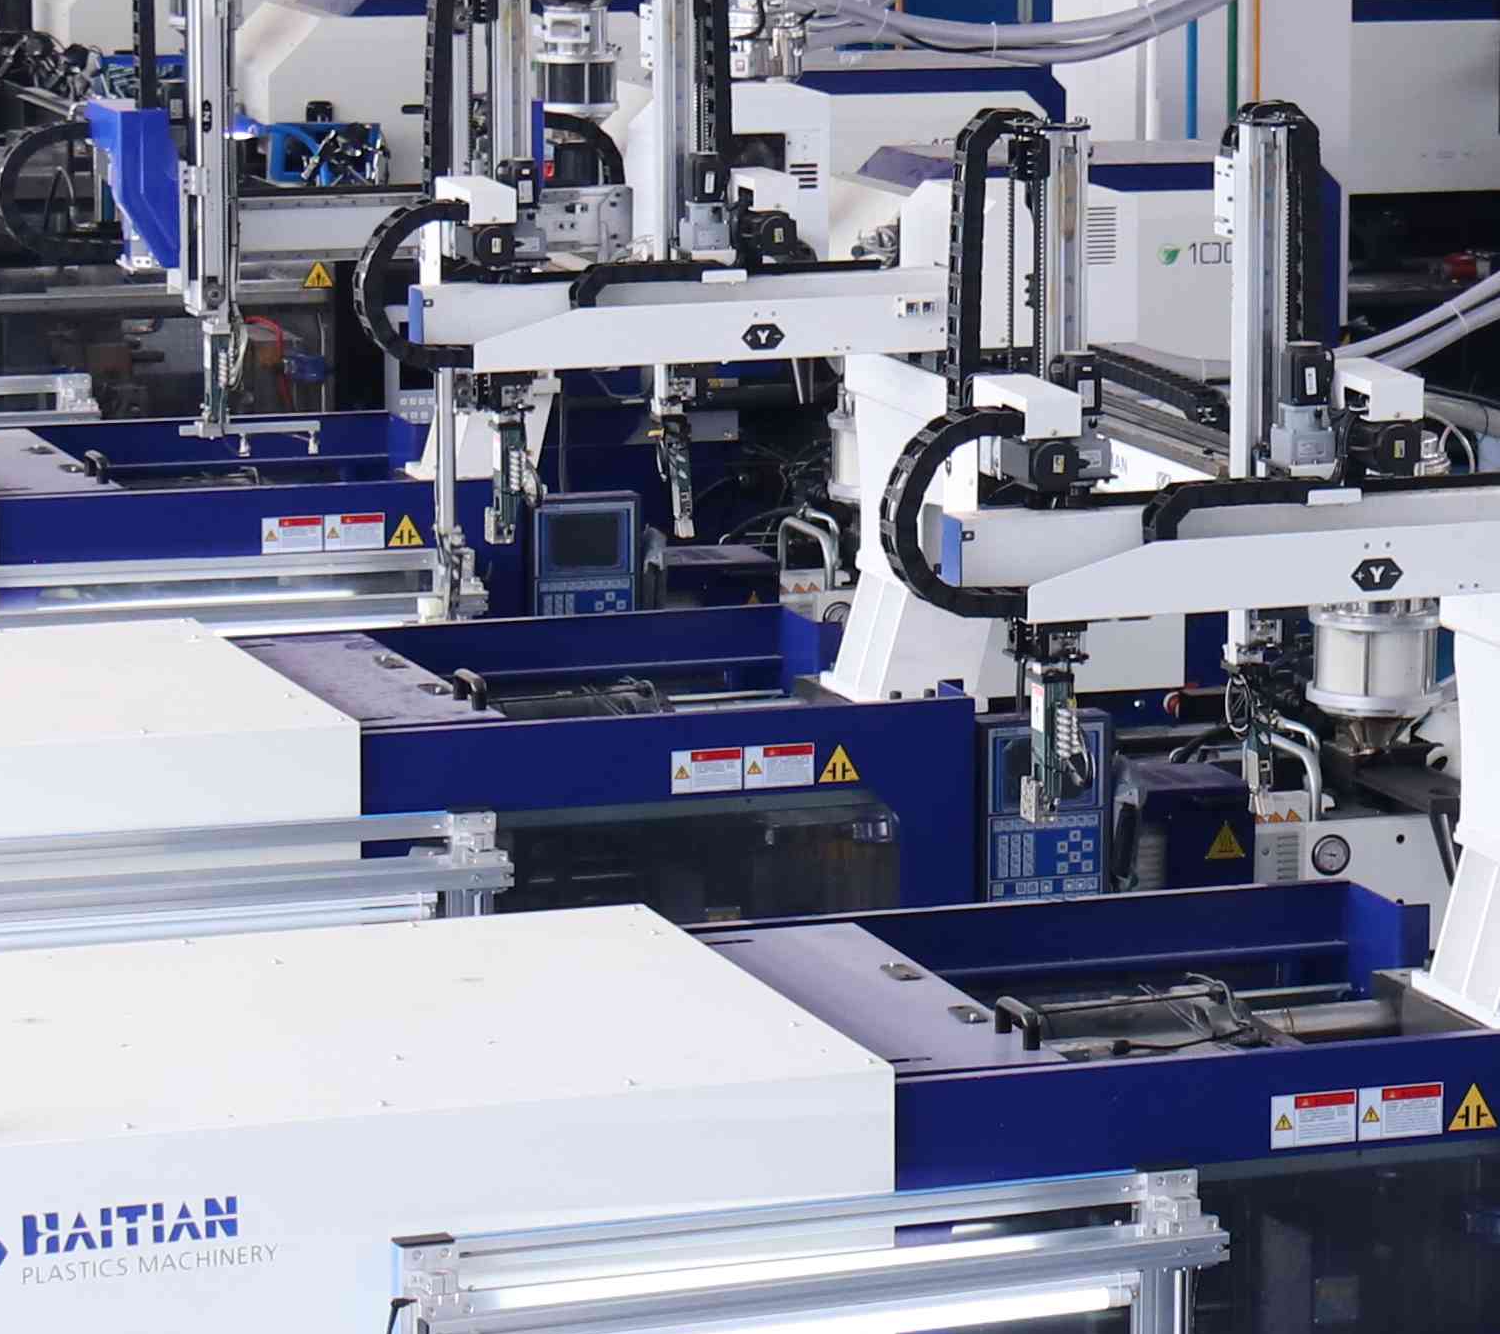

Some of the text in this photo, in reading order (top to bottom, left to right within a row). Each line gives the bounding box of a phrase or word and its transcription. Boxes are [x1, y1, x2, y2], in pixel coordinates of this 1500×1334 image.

[22, 1195, 239, 1257] HAITIAN
[21, 1243, 278, 1285] PLASTICS MACHINERY
